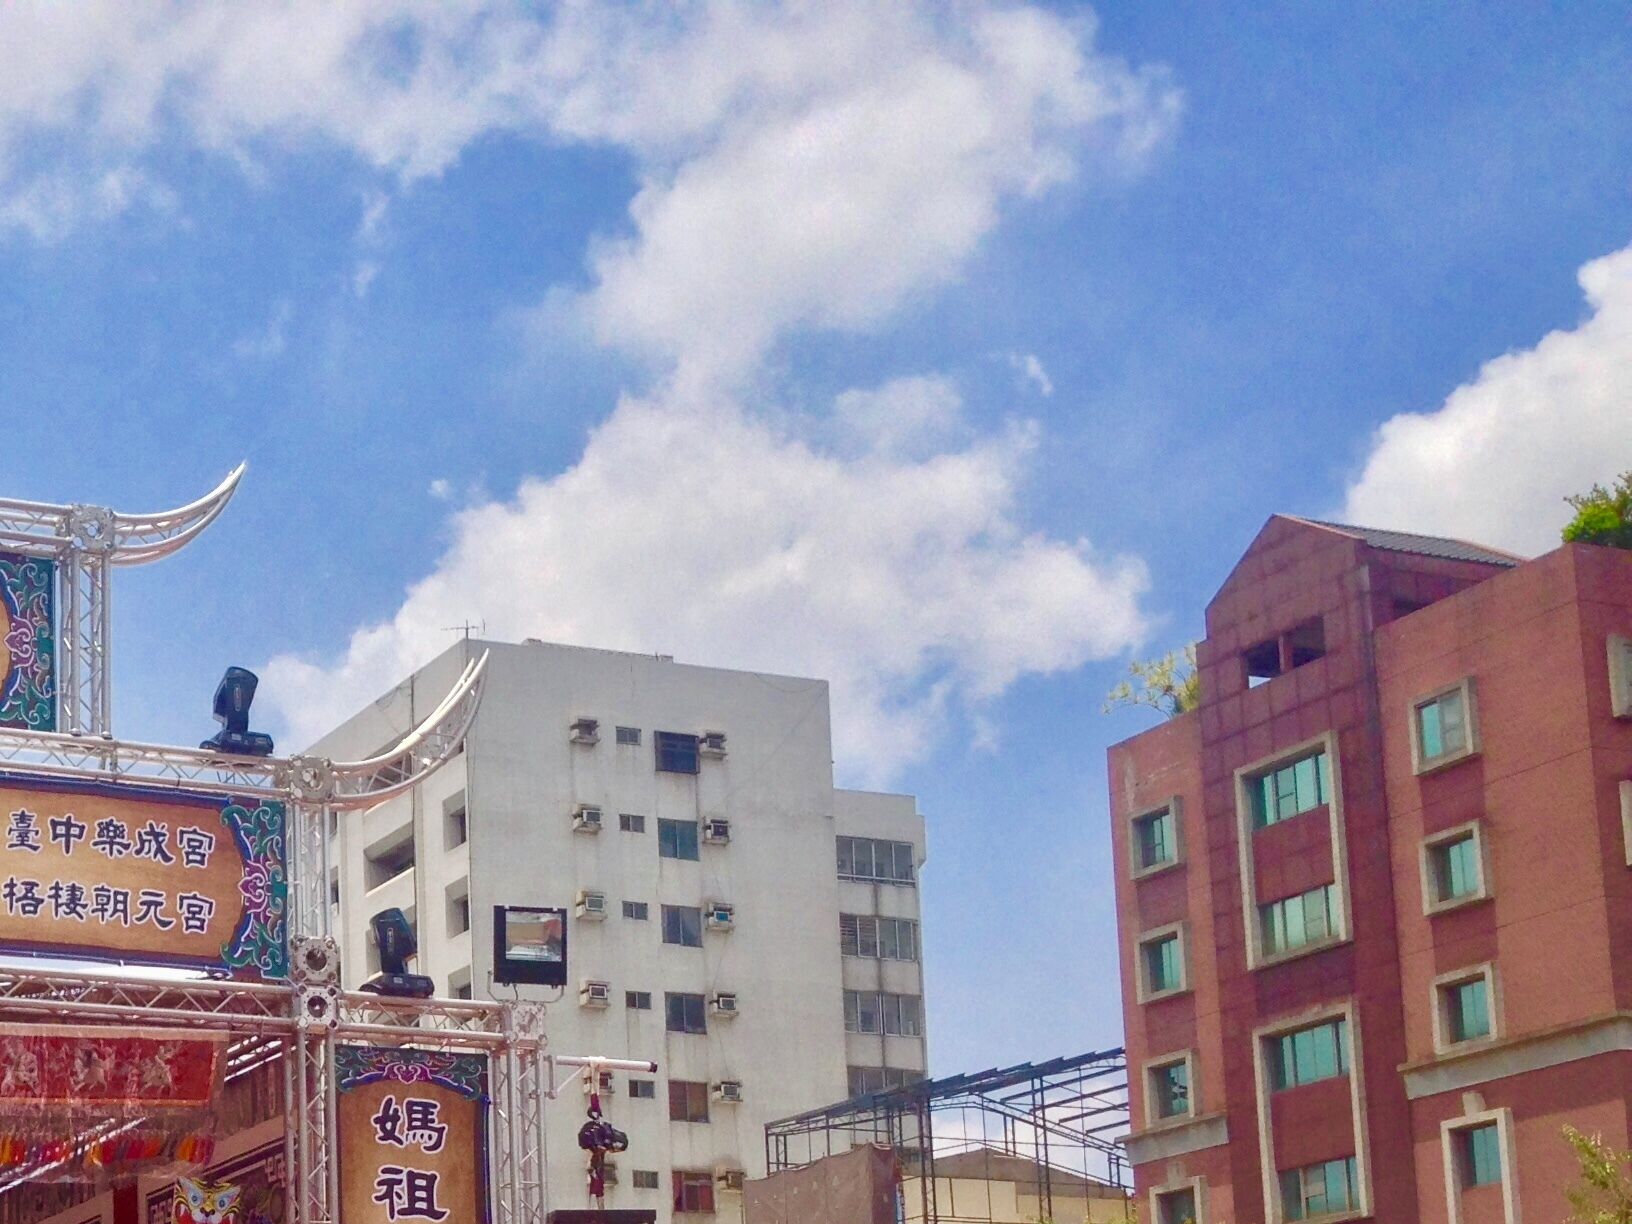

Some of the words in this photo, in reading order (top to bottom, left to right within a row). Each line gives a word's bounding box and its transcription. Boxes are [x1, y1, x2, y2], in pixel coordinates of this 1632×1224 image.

[6, 810, 214, 867] 臺中樂成宮
[2, 877, 214, 932] 梧棲朝元宮
